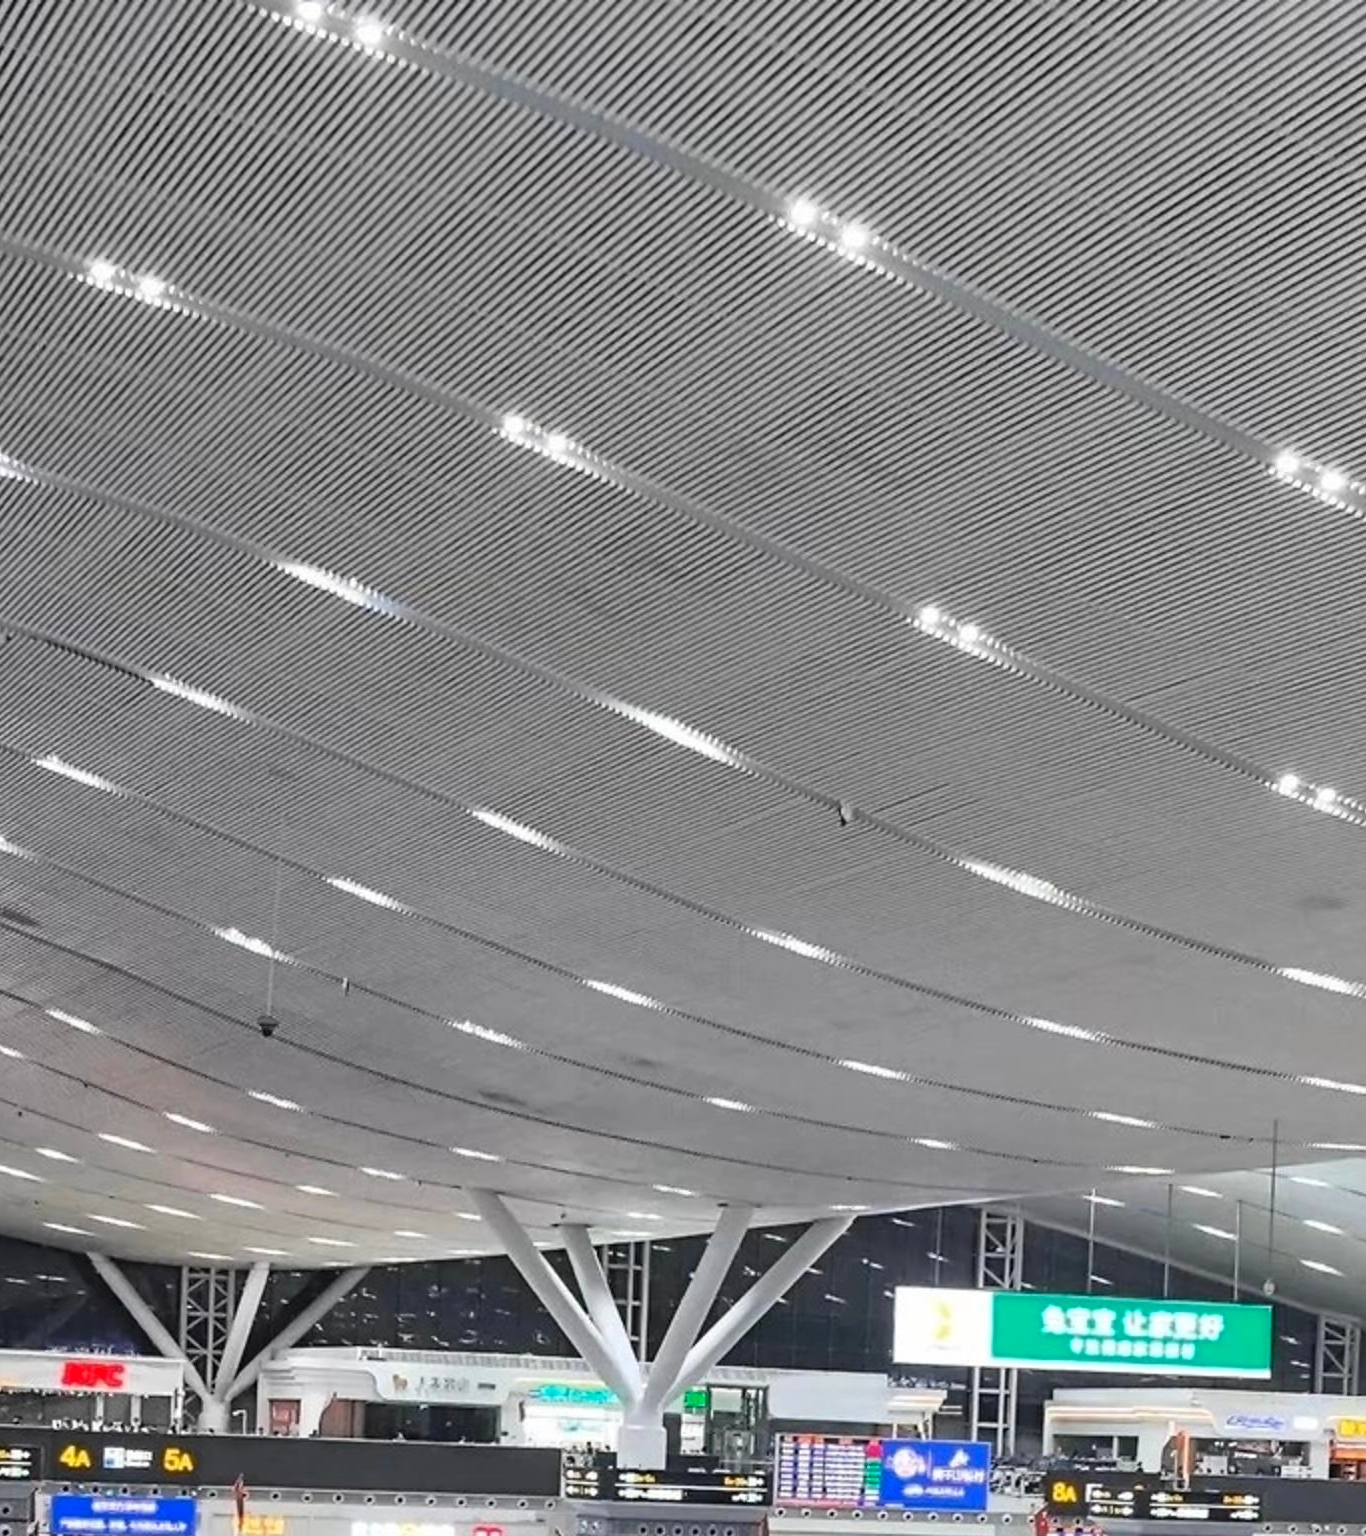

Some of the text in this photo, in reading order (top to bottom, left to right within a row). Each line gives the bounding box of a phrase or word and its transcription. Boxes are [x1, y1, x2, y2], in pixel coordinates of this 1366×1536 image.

[61, 1361, 125, 1389] KFC
[59, 1445, 92, 1469] 4A
[163, 1448, 194, 1472] 5A
[1052, 1481, 1077, 1503] 8A
